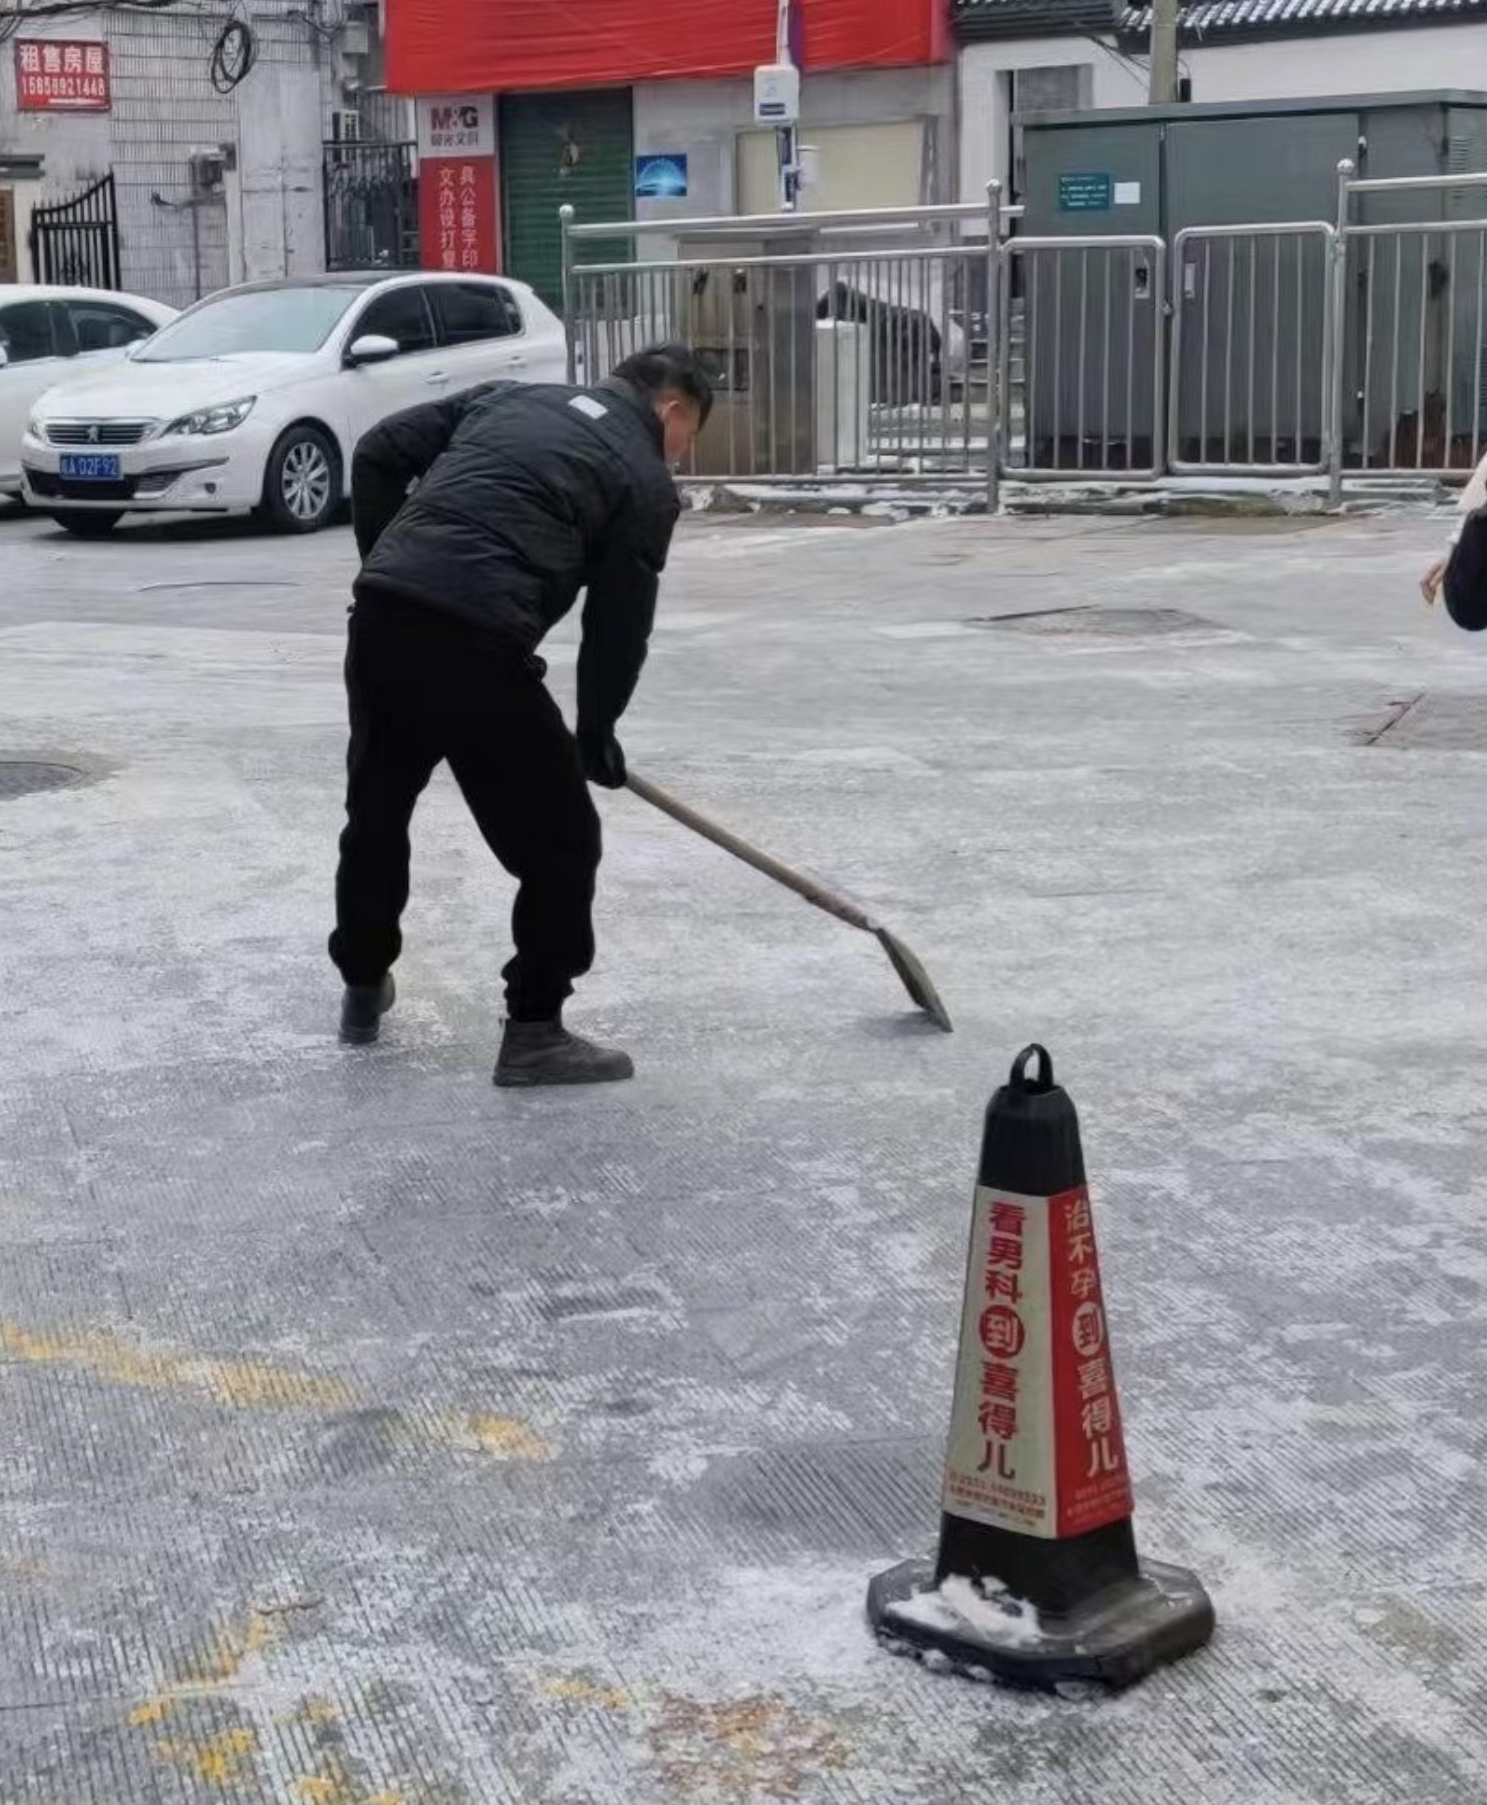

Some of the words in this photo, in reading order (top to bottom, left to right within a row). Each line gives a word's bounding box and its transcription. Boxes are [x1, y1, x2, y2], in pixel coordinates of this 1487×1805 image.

[19, 44, 105, 73] 租售房屋
[977, 1201, 1027, 1480] 看男科到喜得儿
[1064, 1199, 1119, 1479] 治不孕到喜得儿
